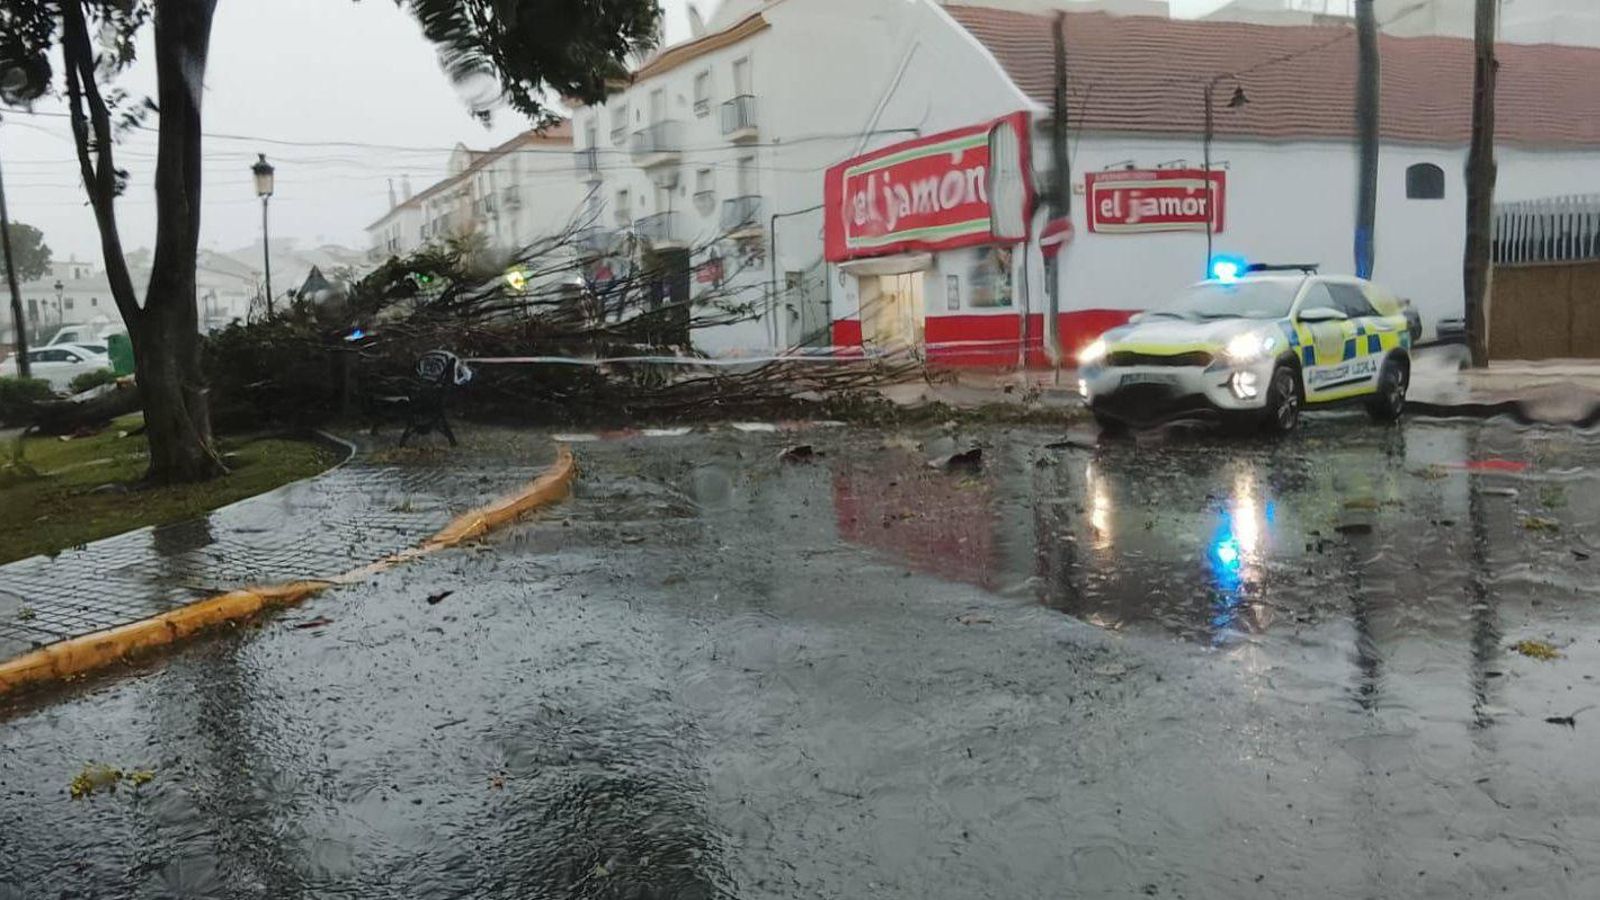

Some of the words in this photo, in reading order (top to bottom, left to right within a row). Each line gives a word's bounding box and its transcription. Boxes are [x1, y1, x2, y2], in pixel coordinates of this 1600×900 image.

[853, 174, 876, 225] el
[883, 151, 988, 231] jamón
[1101, 190, 1121, 217] el
